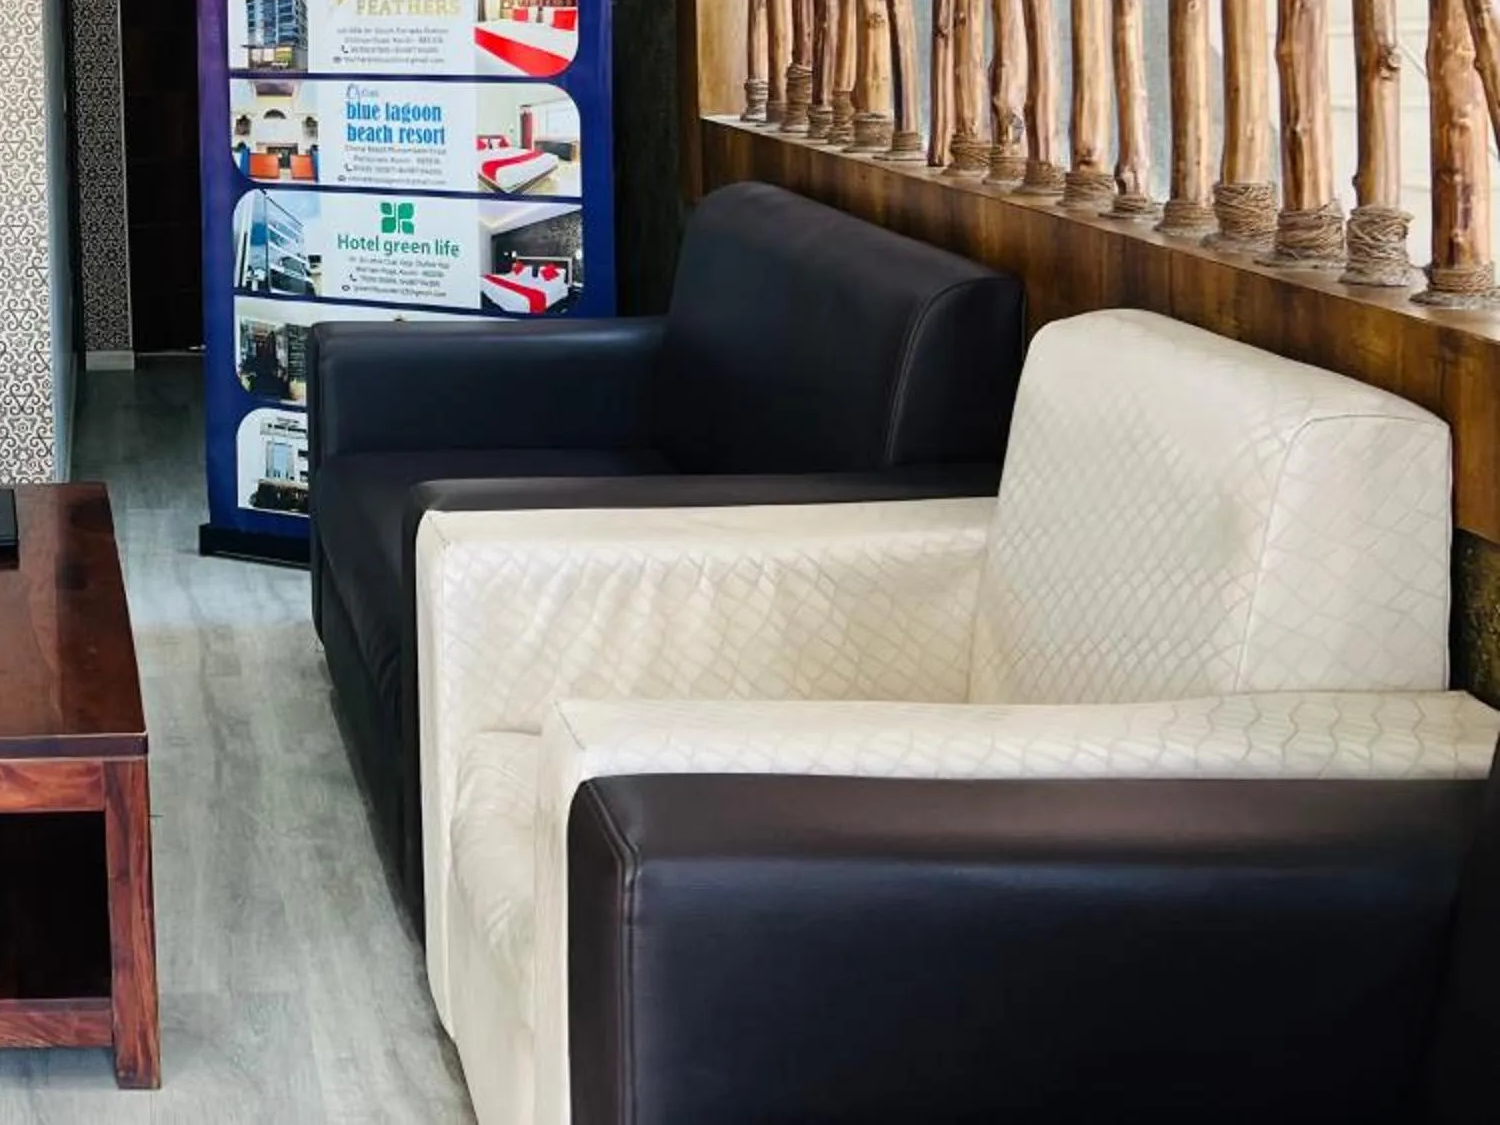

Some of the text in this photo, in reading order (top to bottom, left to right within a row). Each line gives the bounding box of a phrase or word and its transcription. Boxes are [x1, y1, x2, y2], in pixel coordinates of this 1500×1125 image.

[346, 101, 442, 123] blue lagoon
[347, 123, 445, 145] beach resort
[337, 235, 460, 257] Hotel green life
